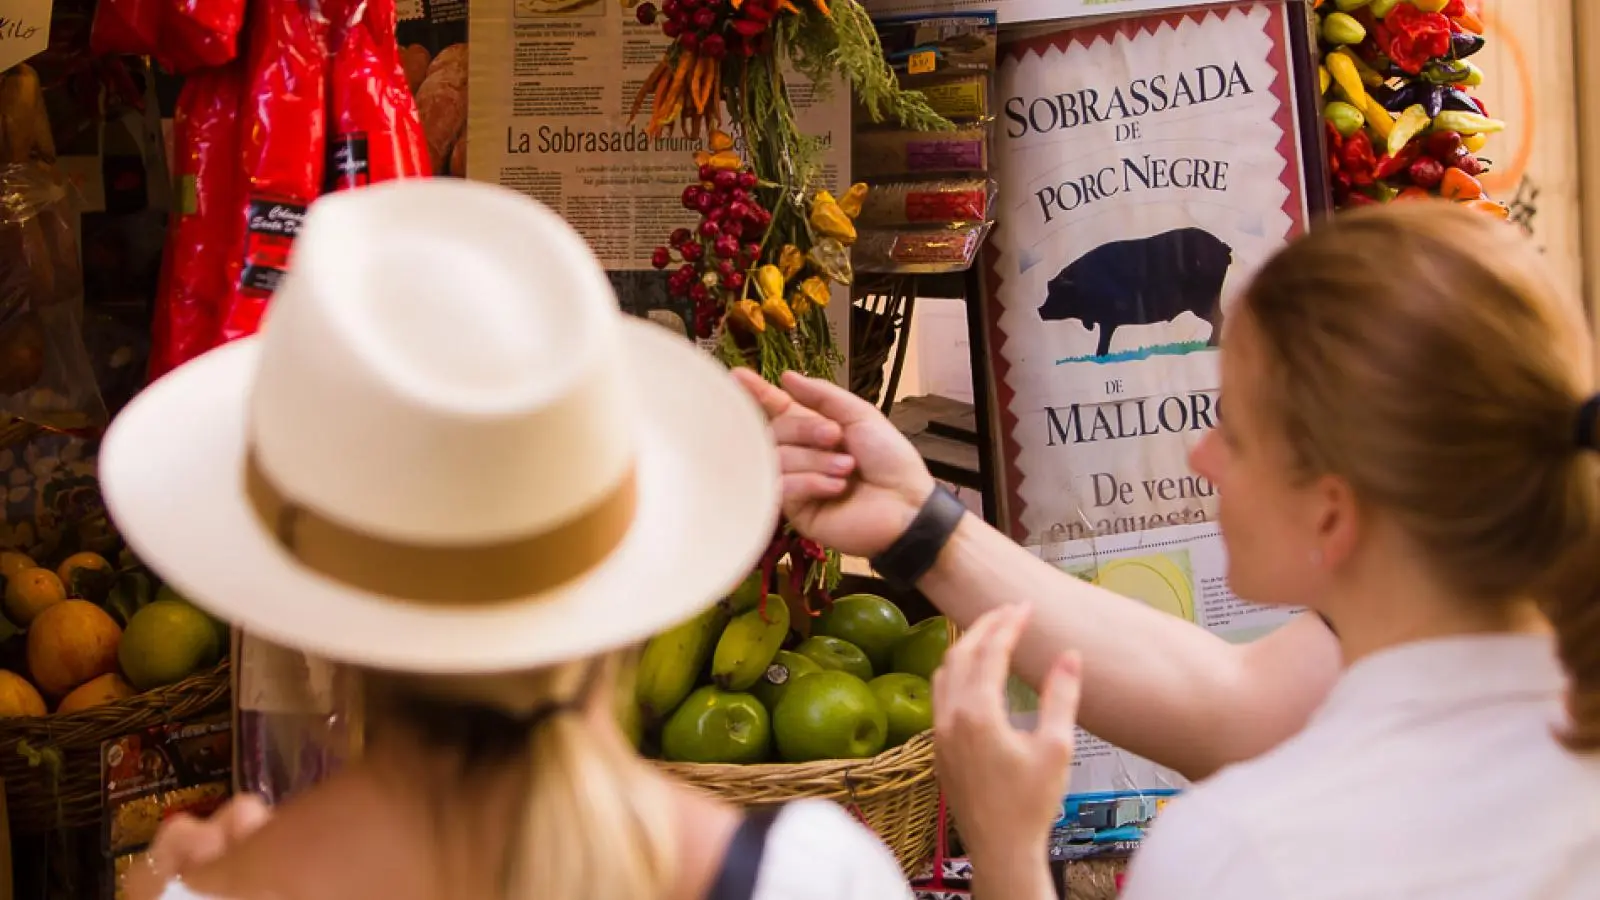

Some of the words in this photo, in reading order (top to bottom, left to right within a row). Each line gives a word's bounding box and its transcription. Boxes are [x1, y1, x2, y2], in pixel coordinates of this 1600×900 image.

[1005, 60, 1253, 139] SOBRASSADA
[507, 126, 530, 154] La
[538, 124, 649, 154] Sobrasada
[1115, 121, 1142, 142] DE
[1035, 167, 1119, 224] PORC
[1122, 153, 1229, 193] NEGRE
[1105, 379, 1124, 395] DE
[1092, 472, 1134, 507] De
[1141, 475, 1222, 501] vend
